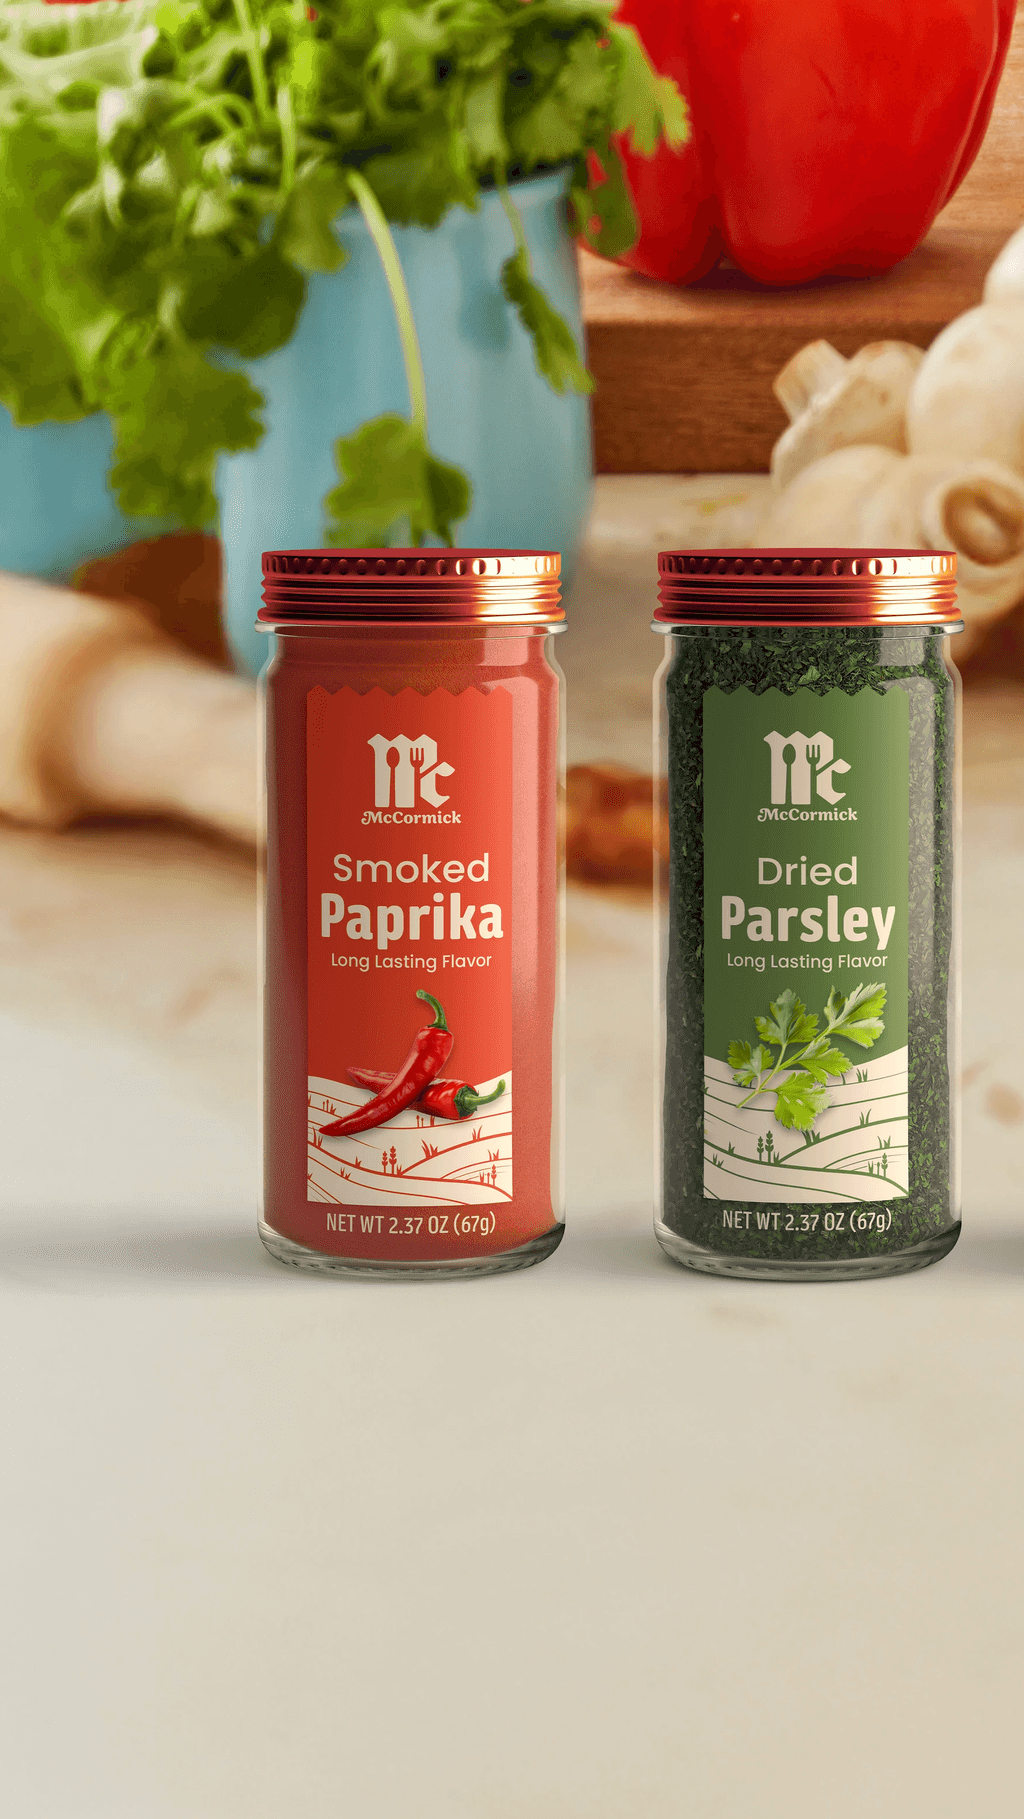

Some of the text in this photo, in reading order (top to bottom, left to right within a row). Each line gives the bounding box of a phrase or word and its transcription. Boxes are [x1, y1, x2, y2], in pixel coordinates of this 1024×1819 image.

[361, 810, 462, 825] McCormick
[757, 808, 858, 822] McCormick
[333, 852, 489, 883] Smoked
[758, 855, 857, 885] Dried
[321, 892, 504, 950] Paprika
[721, 895, 896, 950] Parsley
[331, 953, 492, 972] Long Lasting Flavor
[727, 953, 888, 972] Long Lasting Flavor
[326, 1211, 496, 1236] NET WT 2.37 OZ (67g)
[722, 1208, 892, 1232] NET WT 2.37 OZ (67g)
